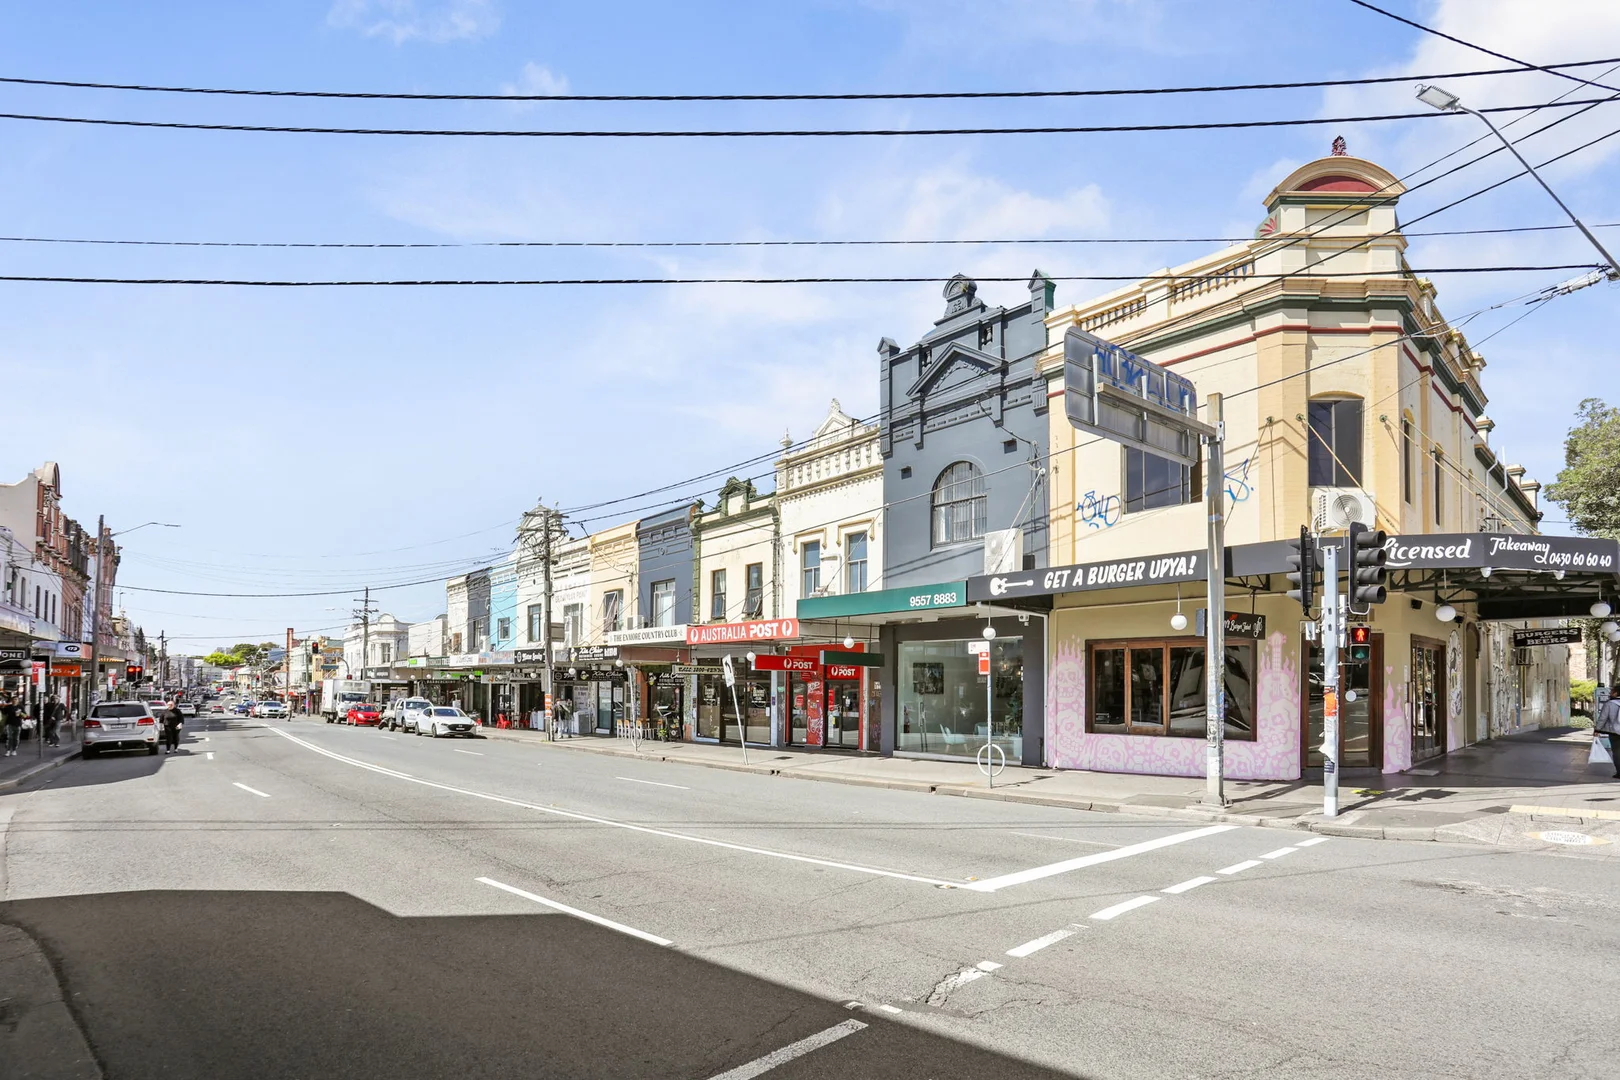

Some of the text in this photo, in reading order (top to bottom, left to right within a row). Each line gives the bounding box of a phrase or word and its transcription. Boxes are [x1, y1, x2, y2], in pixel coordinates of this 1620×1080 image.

[1383, 537, 1471, 565] Licensed
[1490, 536, 1550, 563] Takeaway
[1549, 553, 1612, 567] 0430 60 60 40
[1044, 555, 1198, 589] GET A BURGER UPYA!
[909, 592, 957, 607] 9557 8883
[613, 628, 677, 642] THE ENMORE COUNTRY CLUB
[701, 622, 779, 642] AUSTRALIA POST
[1516, 628, 1578, 640] BURGERS
[1526, 636, 1568, 645] BEERS
[793, 662, 813, 670] POST
[839, 668, 856, 676] POST
